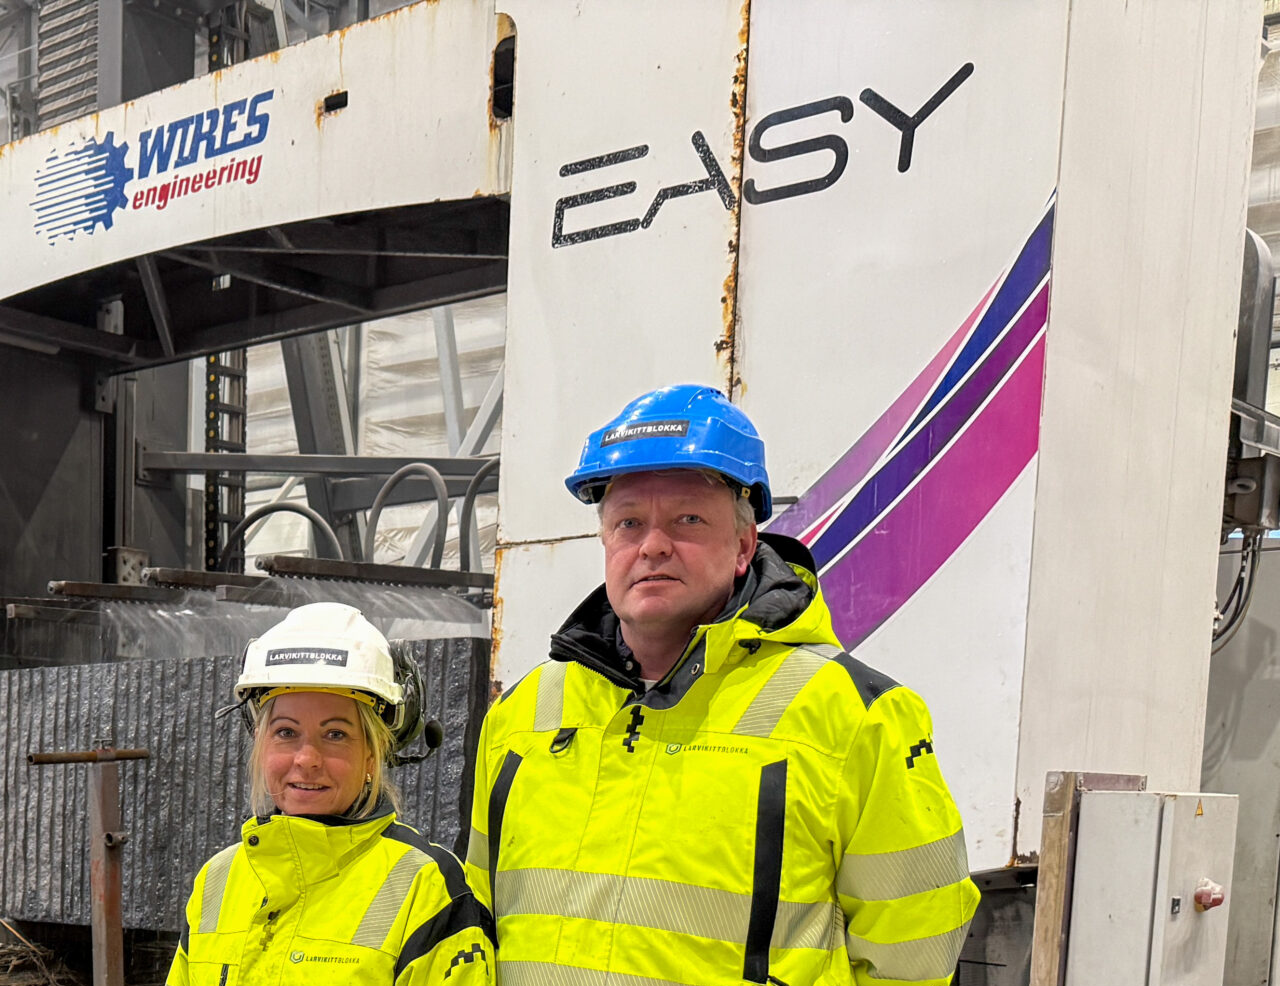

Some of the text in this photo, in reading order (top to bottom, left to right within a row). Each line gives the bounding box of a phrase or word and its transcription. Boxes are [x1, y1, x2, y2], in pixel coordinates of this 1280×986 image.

[137, 89, 274, 180] WIRES
[551, 62, 975, 248] EASY
[132, 154, 263, 210] engineering
[605, 424, 683, 442] LARVIKITTBLOKKA
[269, 652, 343, 661] LARVIKITTBLOKKA
[683, 744, 749, 755] LARVIKITTBLOKKA
[305, 955, 360, 964] LARVIKITTBLOKKA
